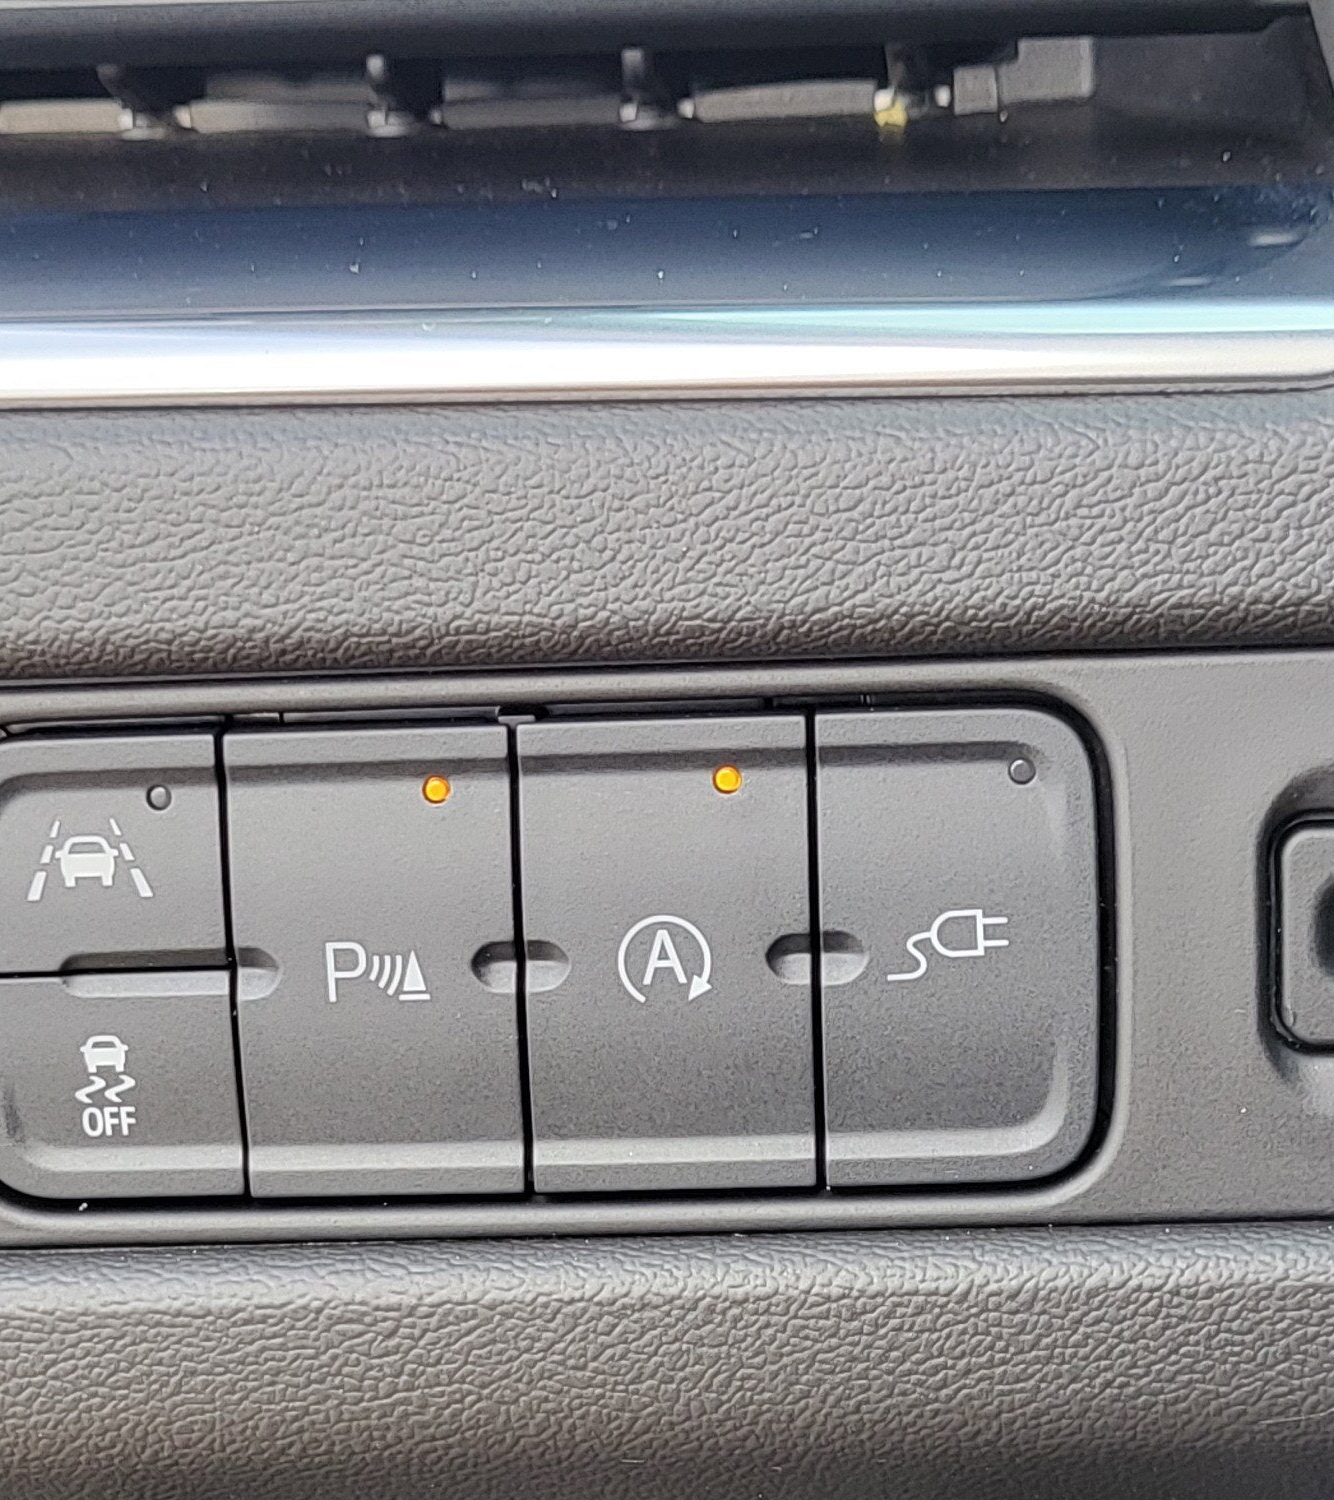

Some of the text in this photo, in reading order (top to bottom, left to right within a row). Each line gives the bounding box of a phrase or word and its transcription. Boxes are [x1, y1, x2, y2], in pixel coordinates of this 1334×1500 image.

[324, 941, 367, 1003] P
[642, 929, 688, 985] A
[81, 1105, 137, 1138] OFF
